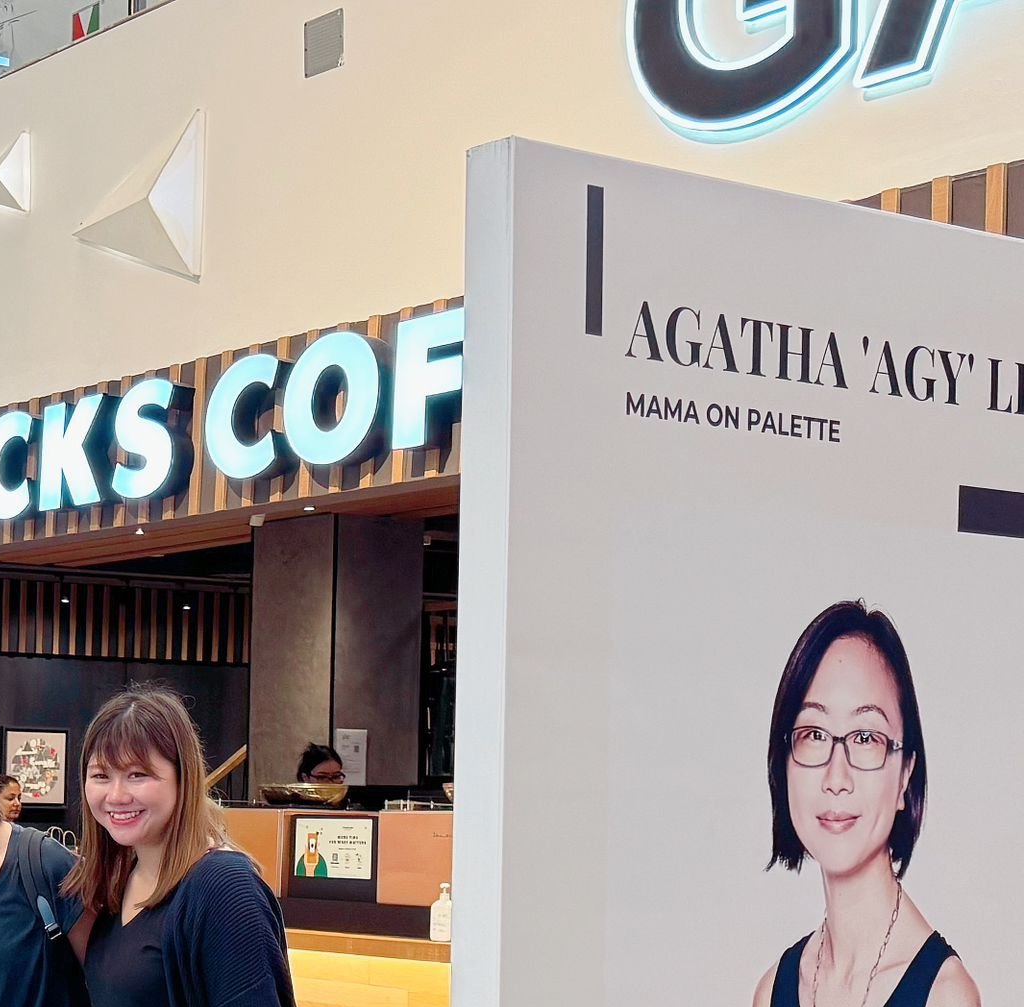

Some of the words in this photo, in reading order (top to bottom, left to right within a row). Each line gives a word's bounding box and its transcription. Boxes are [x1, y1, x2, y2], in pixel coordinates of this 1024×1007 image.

[204, 307, 464, 480] COF
[624, 300, 849, 390] AGATHA
[862, 335, 975, 406] 'AGY'
[626, 391, 700, 421] MAMA
[706, 403, 740, 430] ON
[747, 408, 841, 443] PALETTE
